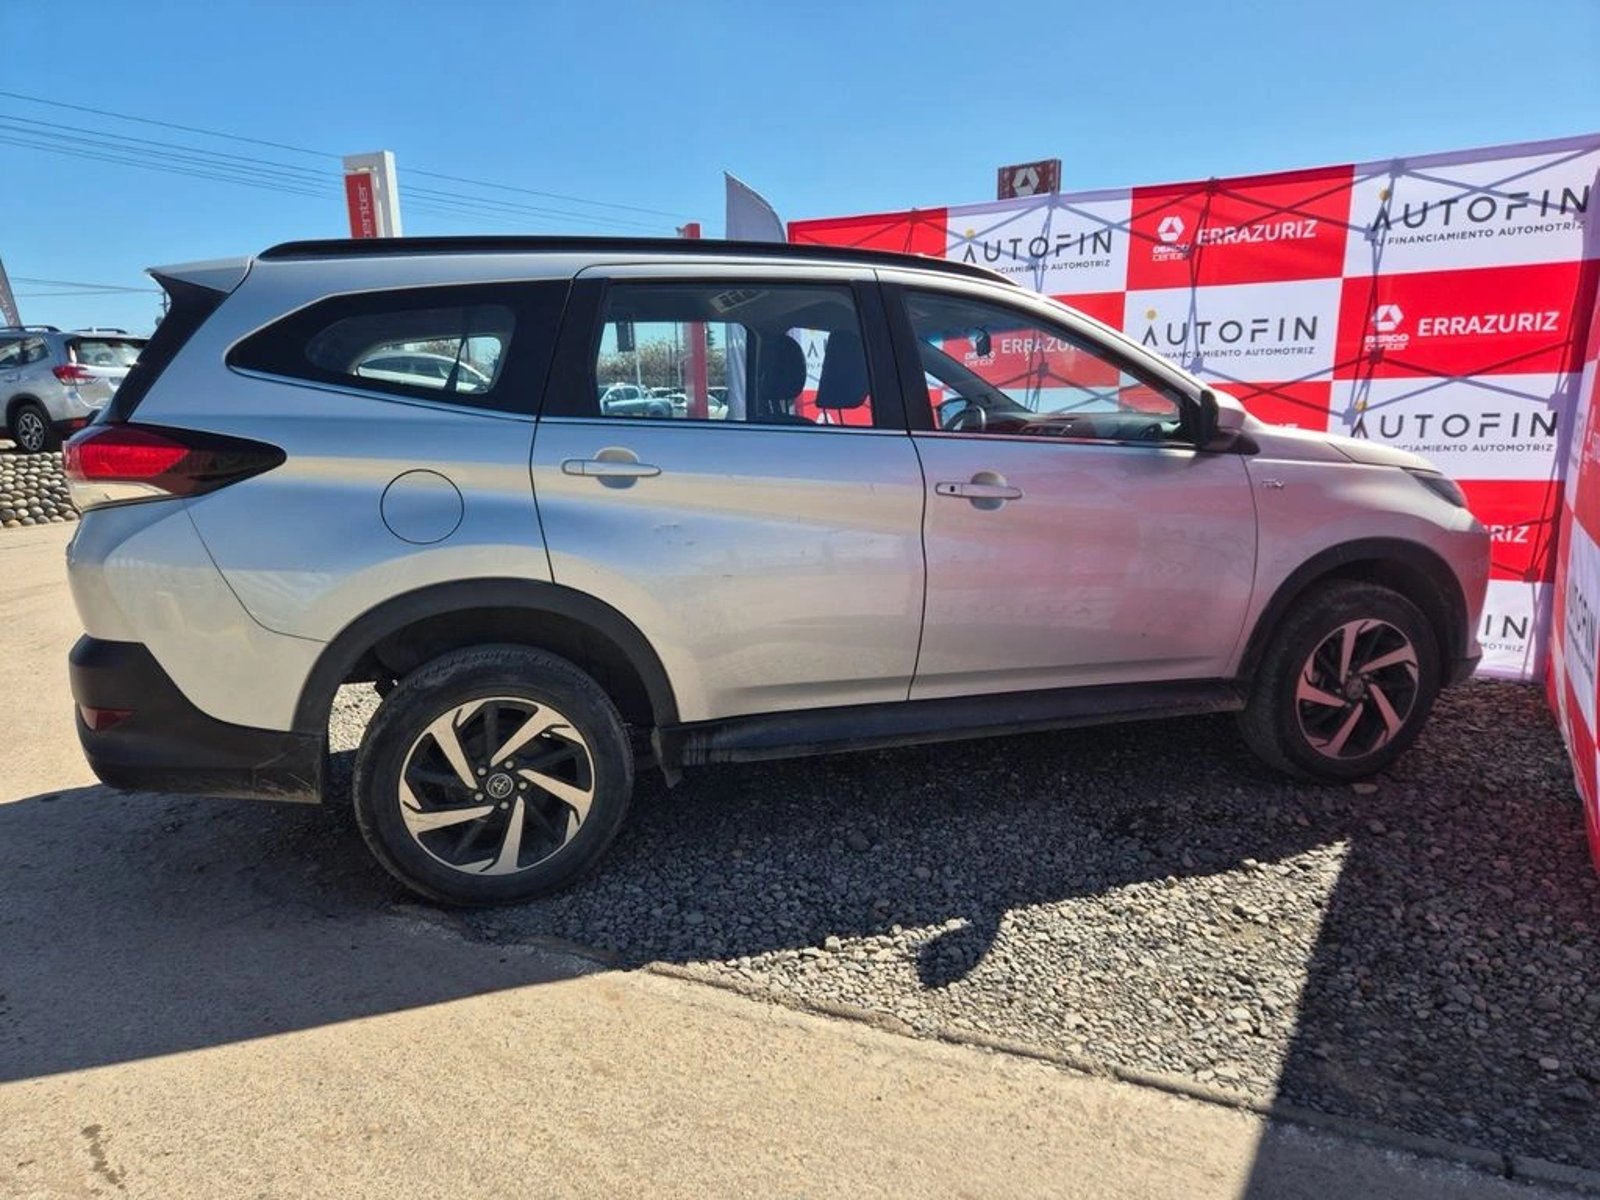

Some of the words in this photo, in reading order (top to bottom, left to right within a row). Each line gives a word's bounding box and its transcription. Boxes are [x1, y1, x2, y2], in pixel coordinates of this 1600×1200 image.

[1371, 185, 1590, 232] AUTOFIN
[1197, 219, 1318, 246] ERRAZURIZ
[1388, 229, 1494, 246] FINANCIAMIENTO
[1498, 219, 1586, 237] AUTOMOTRIZ
[963, 230, 1112, 264] AUTOFIN
[1051, 259, 1111, 271] AUTOMOTRIZ
[1142, 315, 1318, 347] AUTOFIN
[1417, 311, 1560, 337] ERRAZURIZ
[1001, 336, 1080, 354] ERRAZU
[1245, 346, 1316, 357] AUTOMOTRIZ
[1350, 412, 1559, 439] AUTOFIN
[1472, 442, 1554, 452] AUTOMOTRIZ
